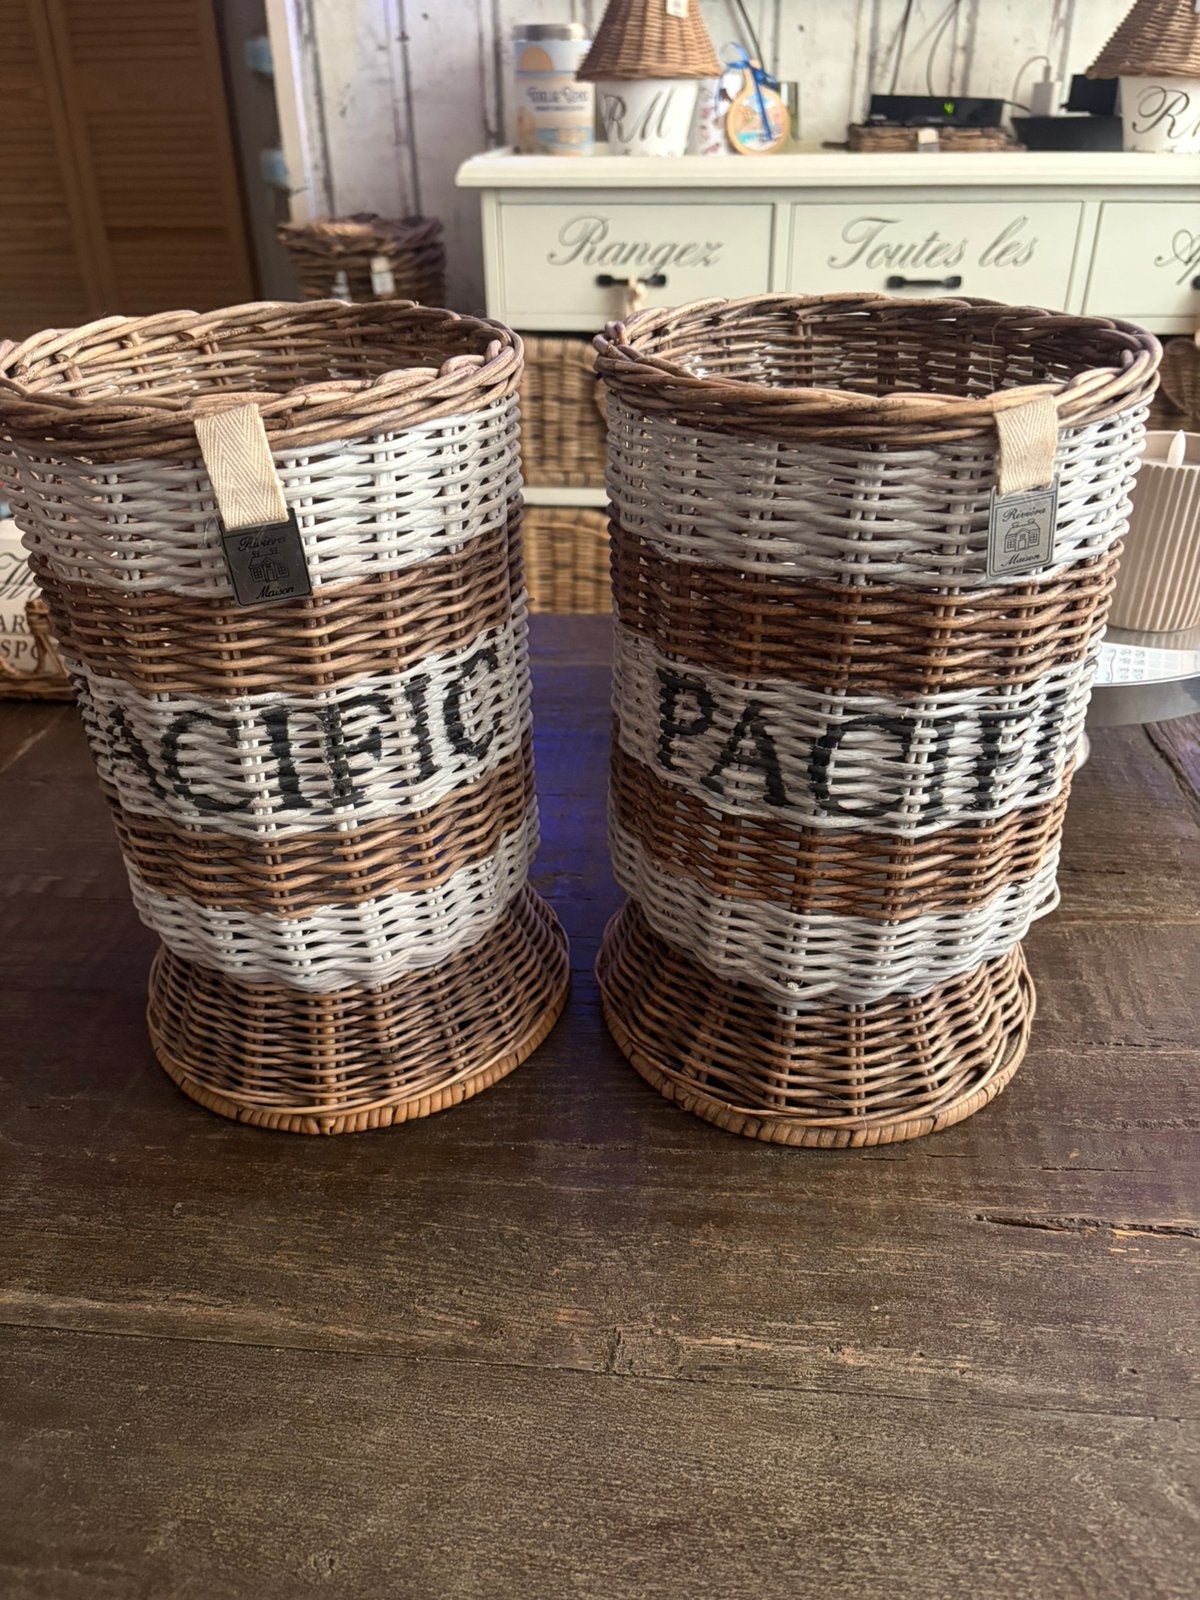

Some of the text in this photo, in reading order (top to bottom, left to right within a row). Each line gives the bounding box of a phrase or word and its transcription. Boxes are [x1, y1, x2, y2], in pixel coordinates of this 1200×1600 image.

[1132, 85, 1200, 139] R
[547, 214, 723, 280] Rangez
[827, 214, 1040, 270] Toutes les
[1000, 553, 1040, 567] Maison
[255, 584, 294, 600] Maison
